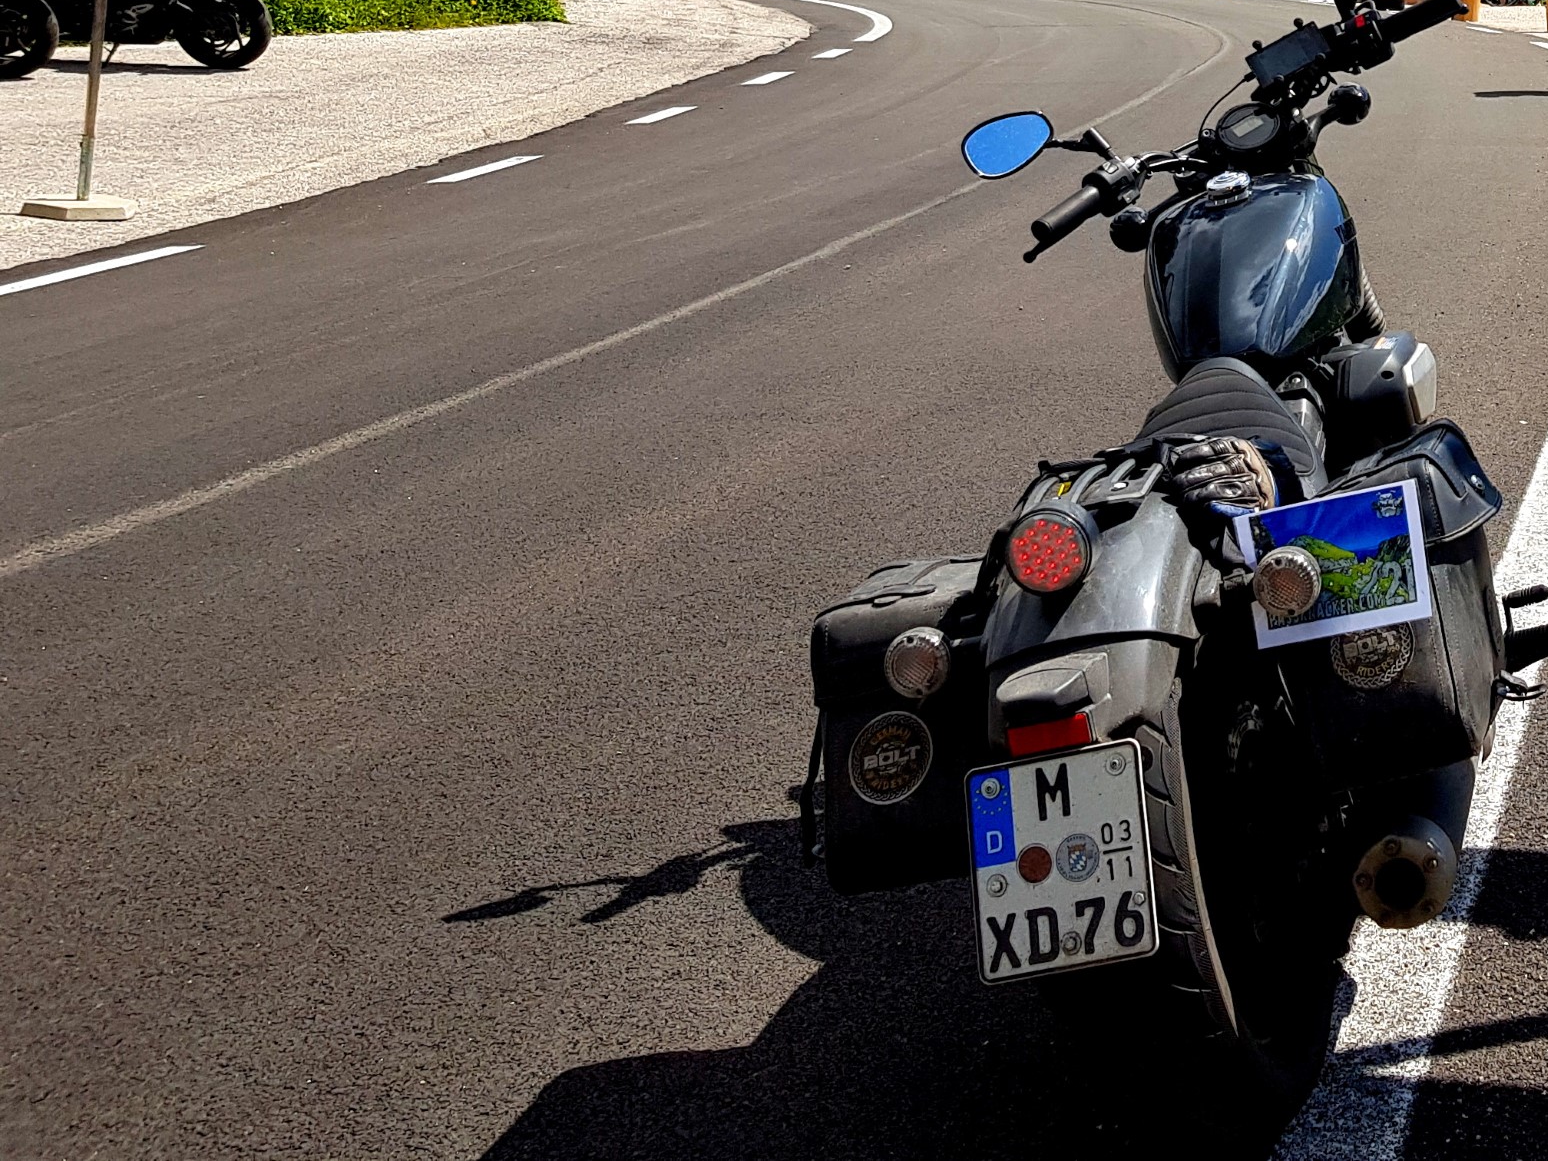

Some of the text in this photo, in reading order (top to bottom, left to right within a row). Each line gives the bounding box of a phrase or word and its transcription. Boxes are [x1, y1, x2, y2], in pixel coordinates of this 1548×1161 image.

[1356, 658, 1394, 677] RIDERS
[863, 745, 921, 771] BOLT
[1035, 762, 1072, 822] M
[986, 830, 1003, 855] D
[1100, 819, 1133, 845] 03
[1106, 855, 1134, 881] 11
[985, 890, 1146, 974] XD 76
